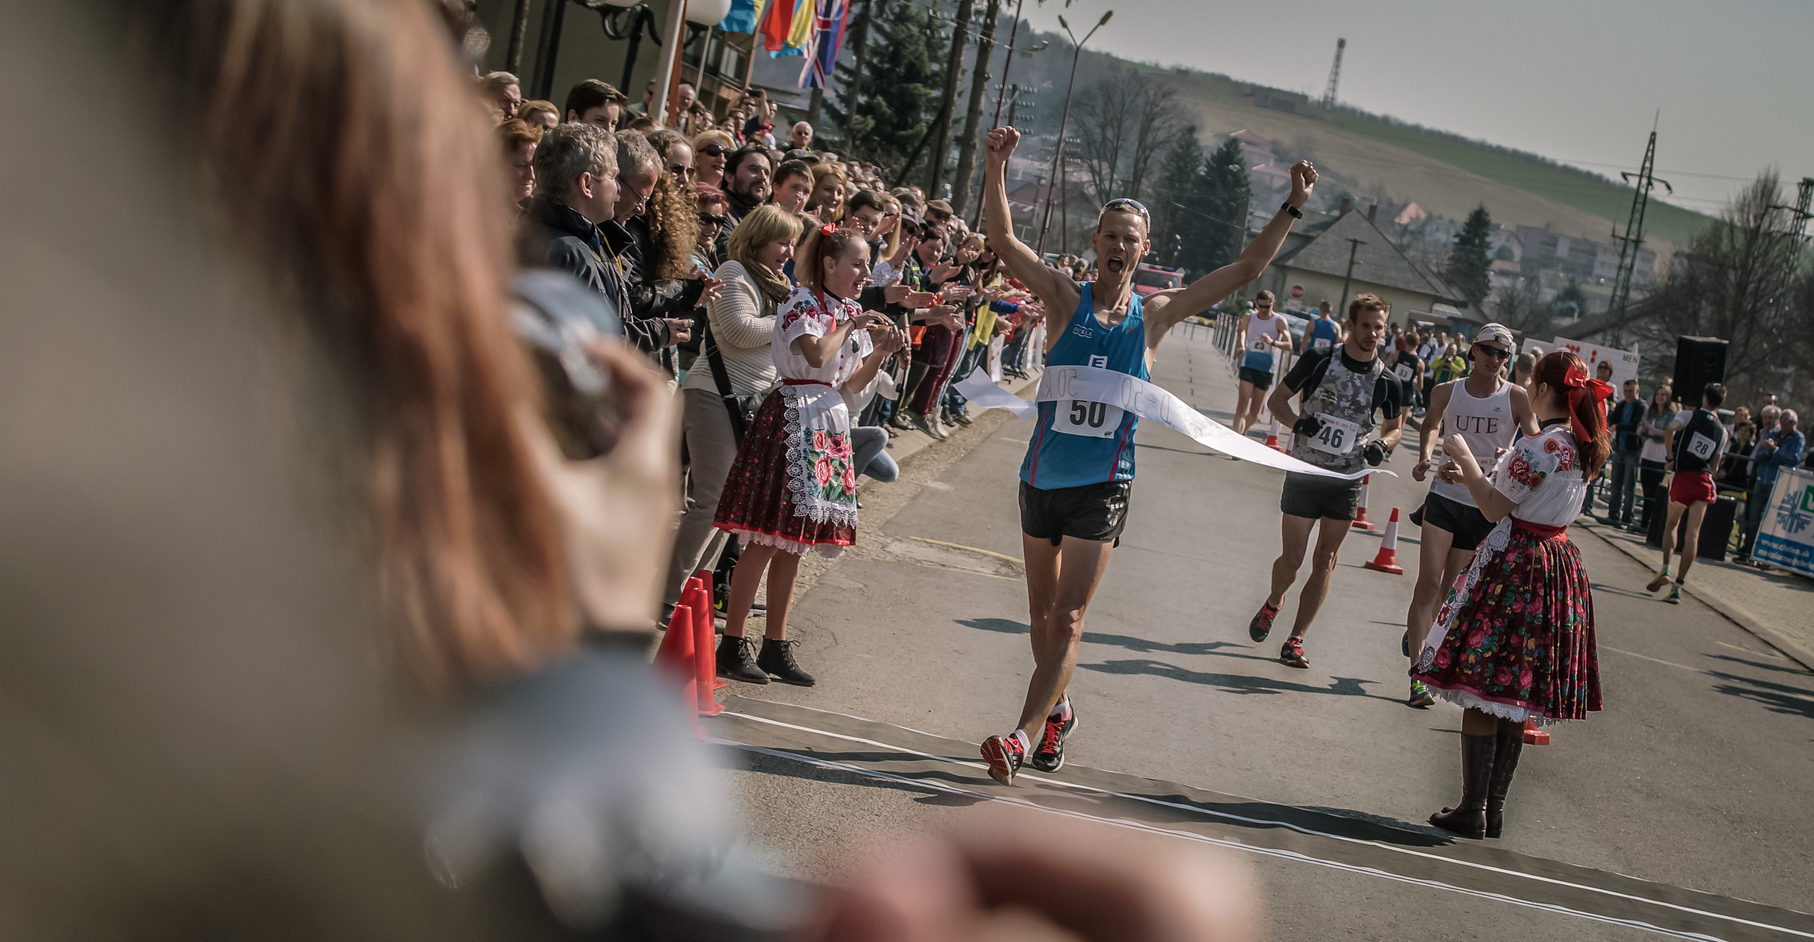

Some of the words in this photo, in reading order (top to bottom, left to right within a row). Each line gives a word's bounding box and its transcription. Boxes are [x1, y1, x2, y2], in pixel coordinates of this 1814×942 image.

[1254, 341, 1265, 351] 23
[1069, 400, 1107, 428] 50
[1455, 414, 1499, 434] UTE
[1318, 425, 1345, 449] 46
[1694, 440, 1709, 455] 28
